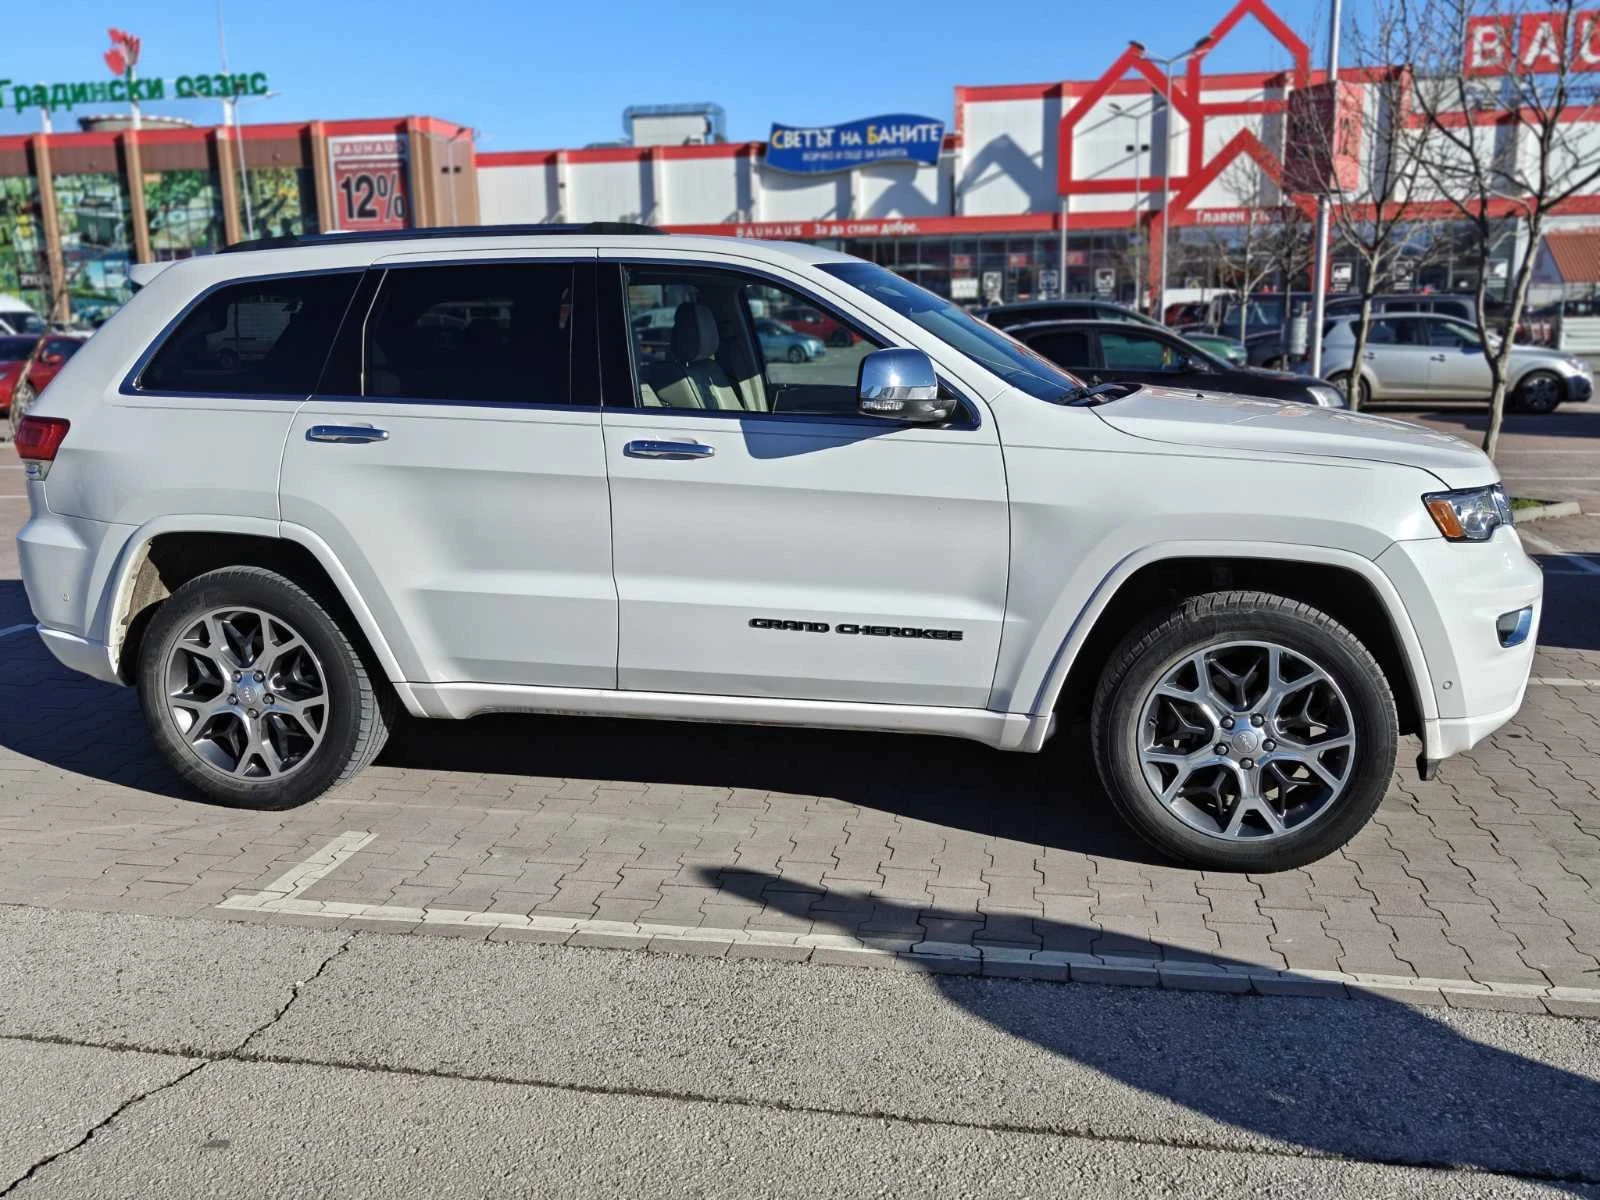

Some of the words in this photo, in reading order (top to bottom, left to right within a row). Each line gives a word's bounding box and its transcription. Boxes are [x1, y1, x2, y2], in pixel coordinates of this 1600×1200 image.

[0, 76, 165, 113] Градински
[175, 72, 268, 98] оазис
[771, 128, 836, 149] СВЕТЪТ
[867, 124, 939, 145] БАНИТЕ
[341, 172, 406, 221] 12%
[735, 224, 802, 238] BAUHAUS
[749, 618, 830, 633] GRAND
[835, 623, 963, 641] CHEROKEE
